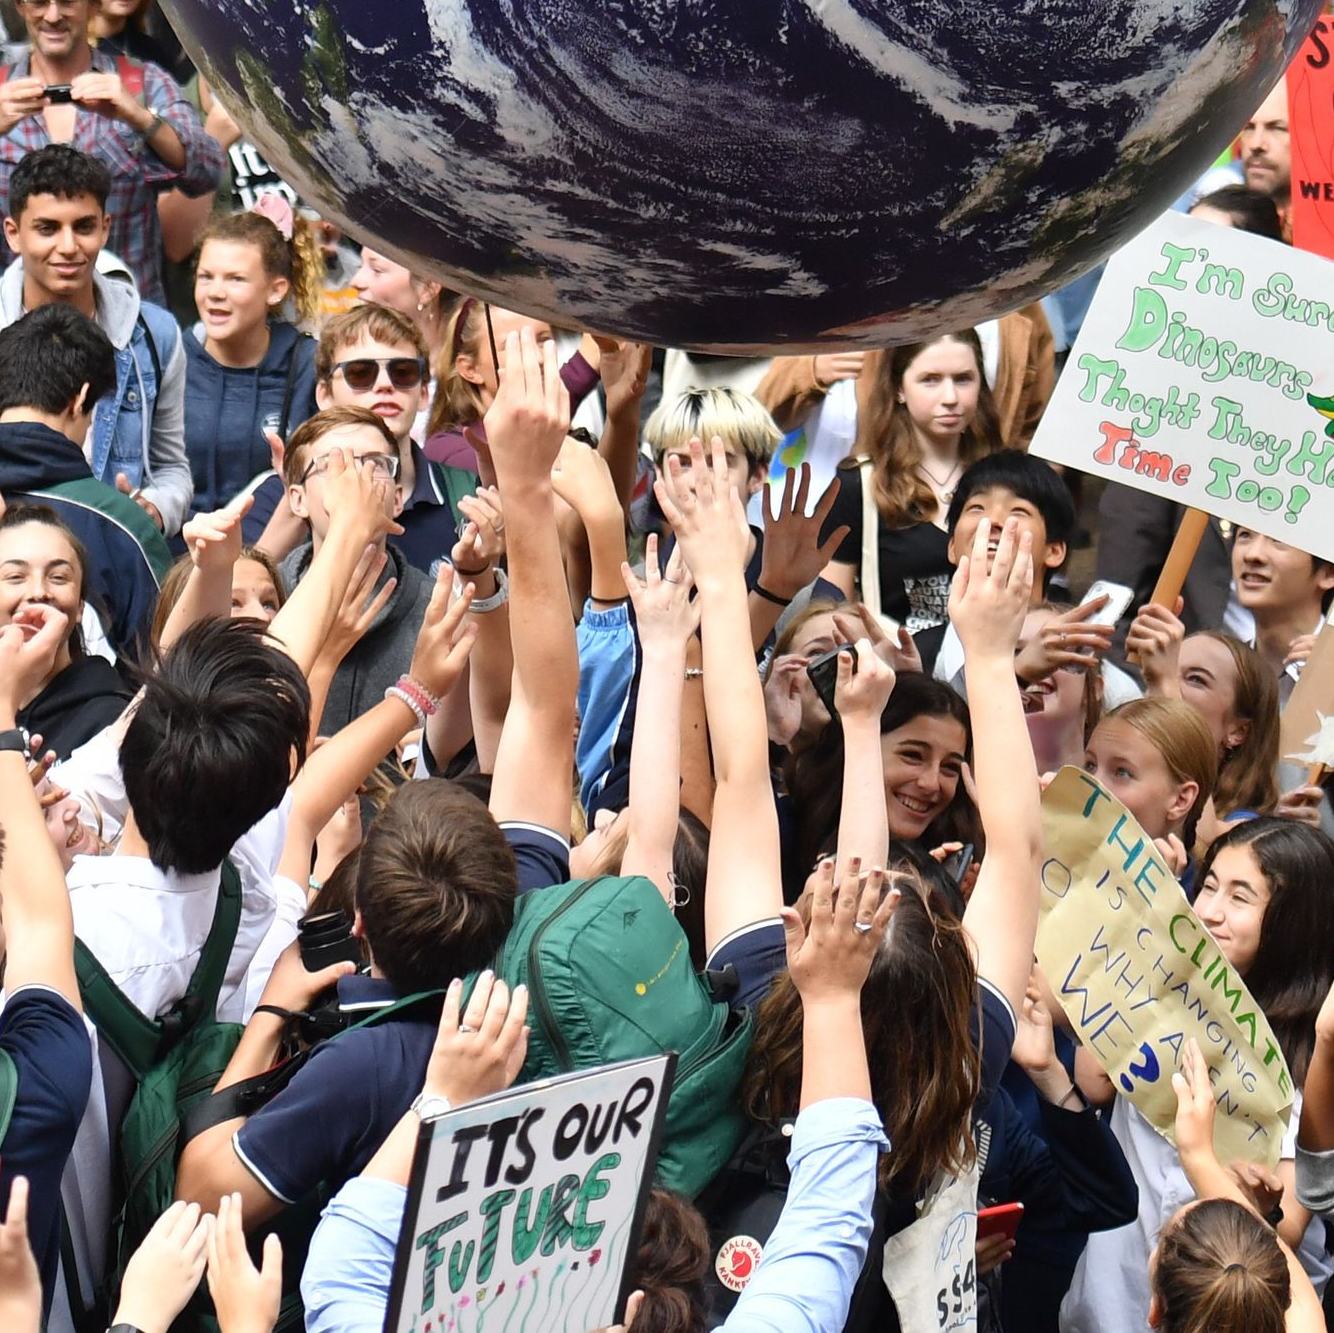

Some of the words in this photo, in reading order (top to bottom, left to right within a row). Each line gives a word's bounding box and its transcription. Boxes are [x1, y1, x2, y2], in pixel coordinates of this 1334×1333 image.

[1148, 242, 1244, 299] I'm
[1115, 287, 1314, 401] Dinosaurs
[1078, 354, 1201, 438] Thoght
[1207, 396, 1291, 476] They
[1093, 421, 1192, 486] Time
[1204, 457, 1312, 524] Too!
[1079, 774, 1165, 908] THE
[1168, 912, 1291, 1100] CLIMATE
[1095, 869, 1128, 911] IS
[1136, 927, 1257, 1094] CHANGING
[1089, 925, 1159, 1012] WHY
[1158, 1031, 1269, 1144] AEN'T
[551, 1076, 655, 1161] OUR
